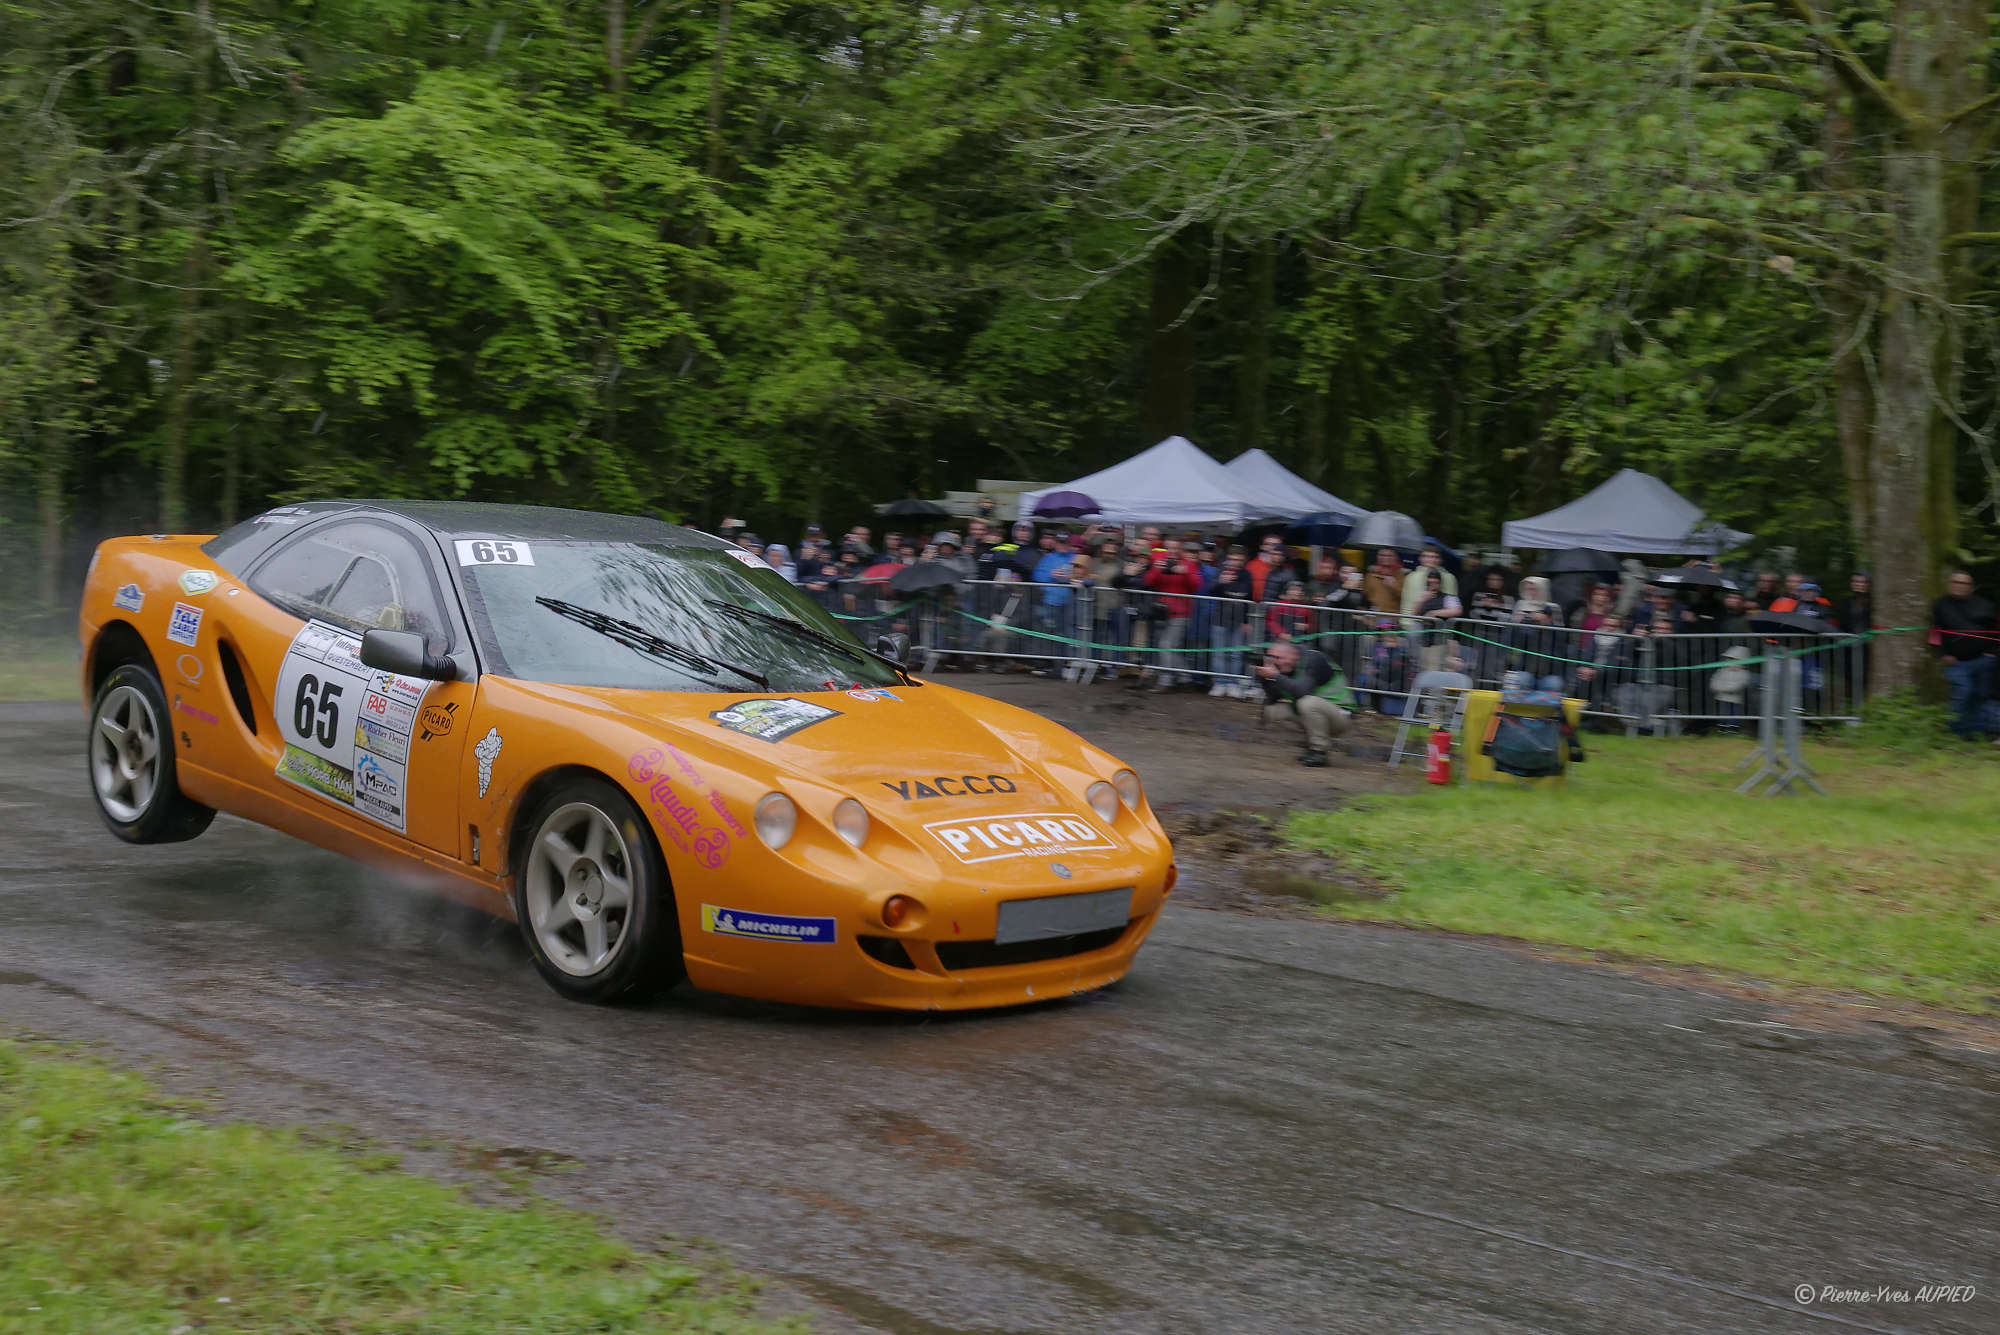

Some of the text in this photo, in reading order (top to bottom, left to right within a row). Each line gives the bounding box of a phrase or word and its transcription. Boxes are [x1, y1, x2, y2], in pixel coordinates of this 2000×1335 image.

[471, 541, 519, 562] 65
[327, 653, 372, 673] QUESTEMBERT
[294, 673, 344, 749] 65
[367, 693, 387, 715] FAB
[423, 709, 451, 729] PICARD
[880, 774, 1017, 801] YACCO
[937, 818, 1100, 854] PICARD
[1021, 844, 1067, 858] RACING
[737, 919, 820, 937] MICHELIN
